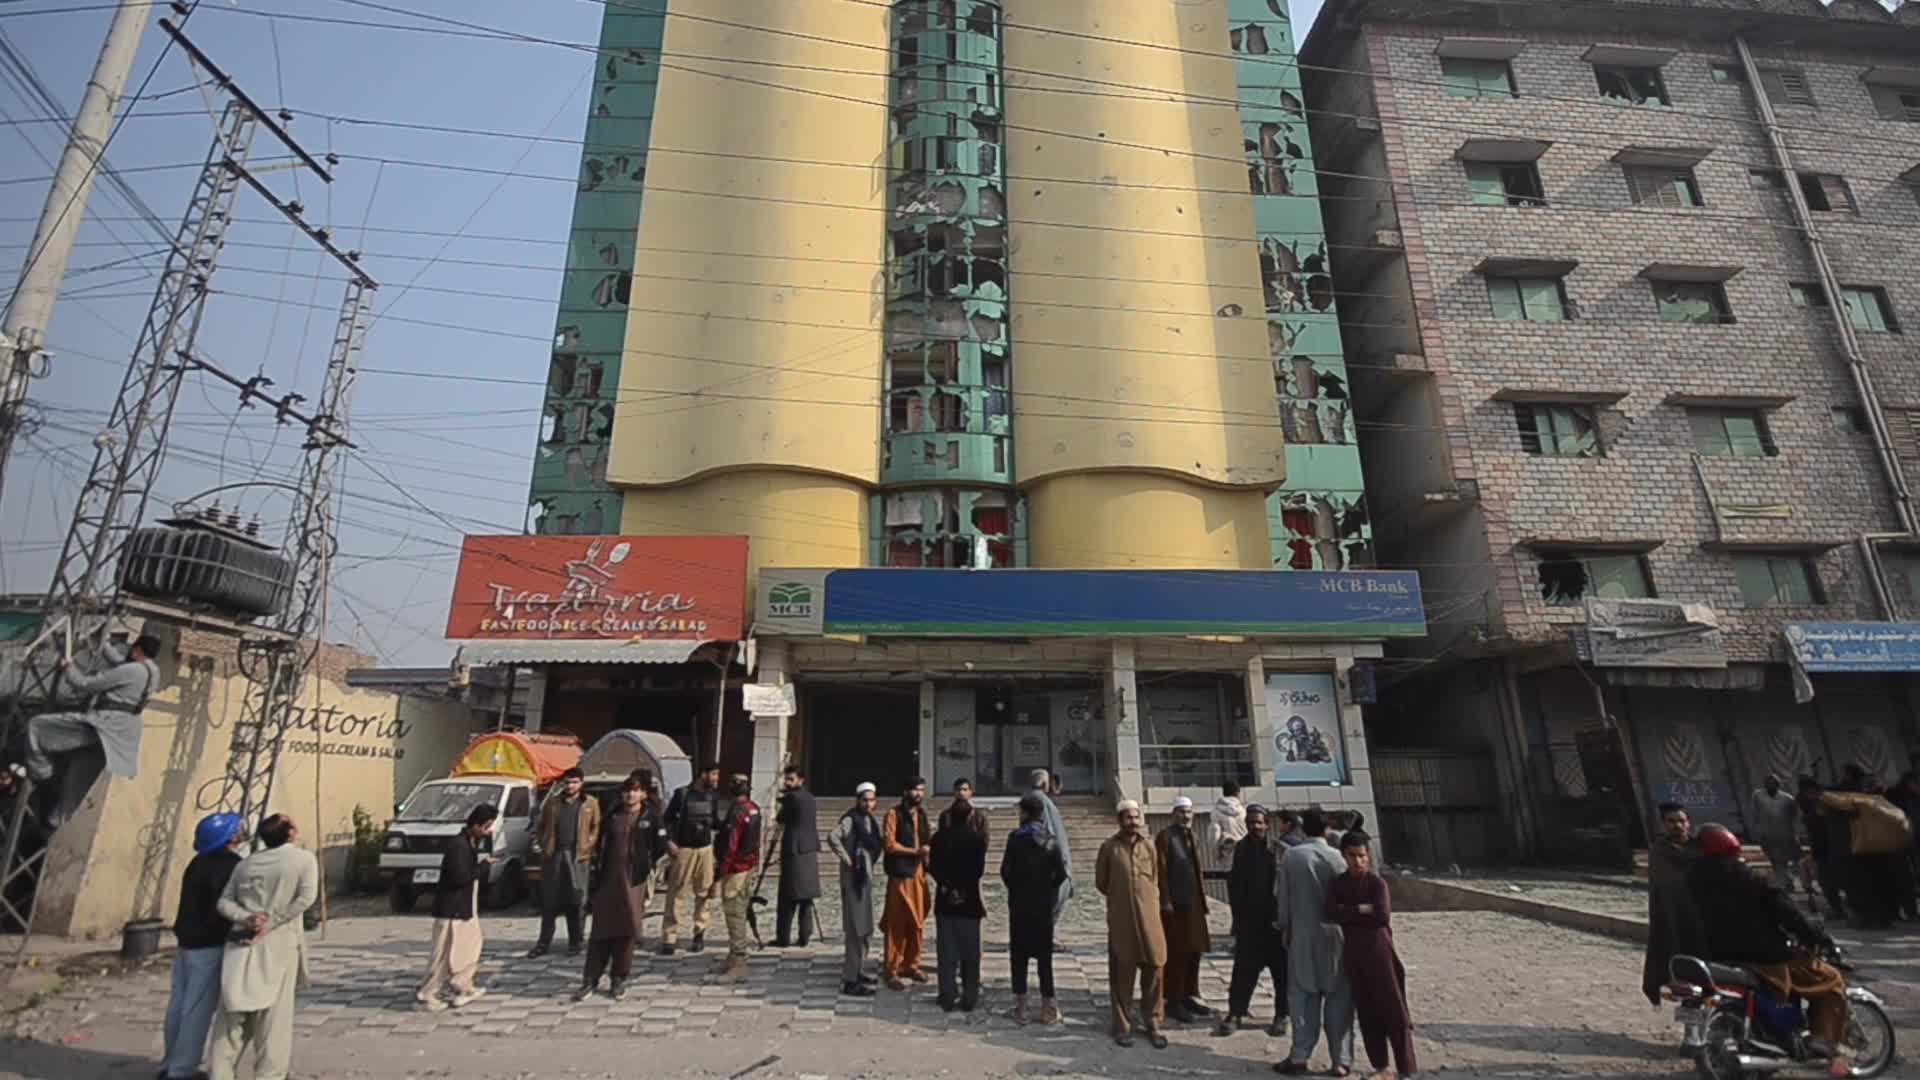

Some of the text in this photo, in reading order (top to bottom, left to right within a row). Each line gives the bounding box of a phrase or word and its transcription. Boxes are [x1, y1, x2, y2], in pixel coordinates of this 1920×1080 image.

[1320, 578, 1408, 592] MCB Bank
[769, 605, 812, 615] MCB
